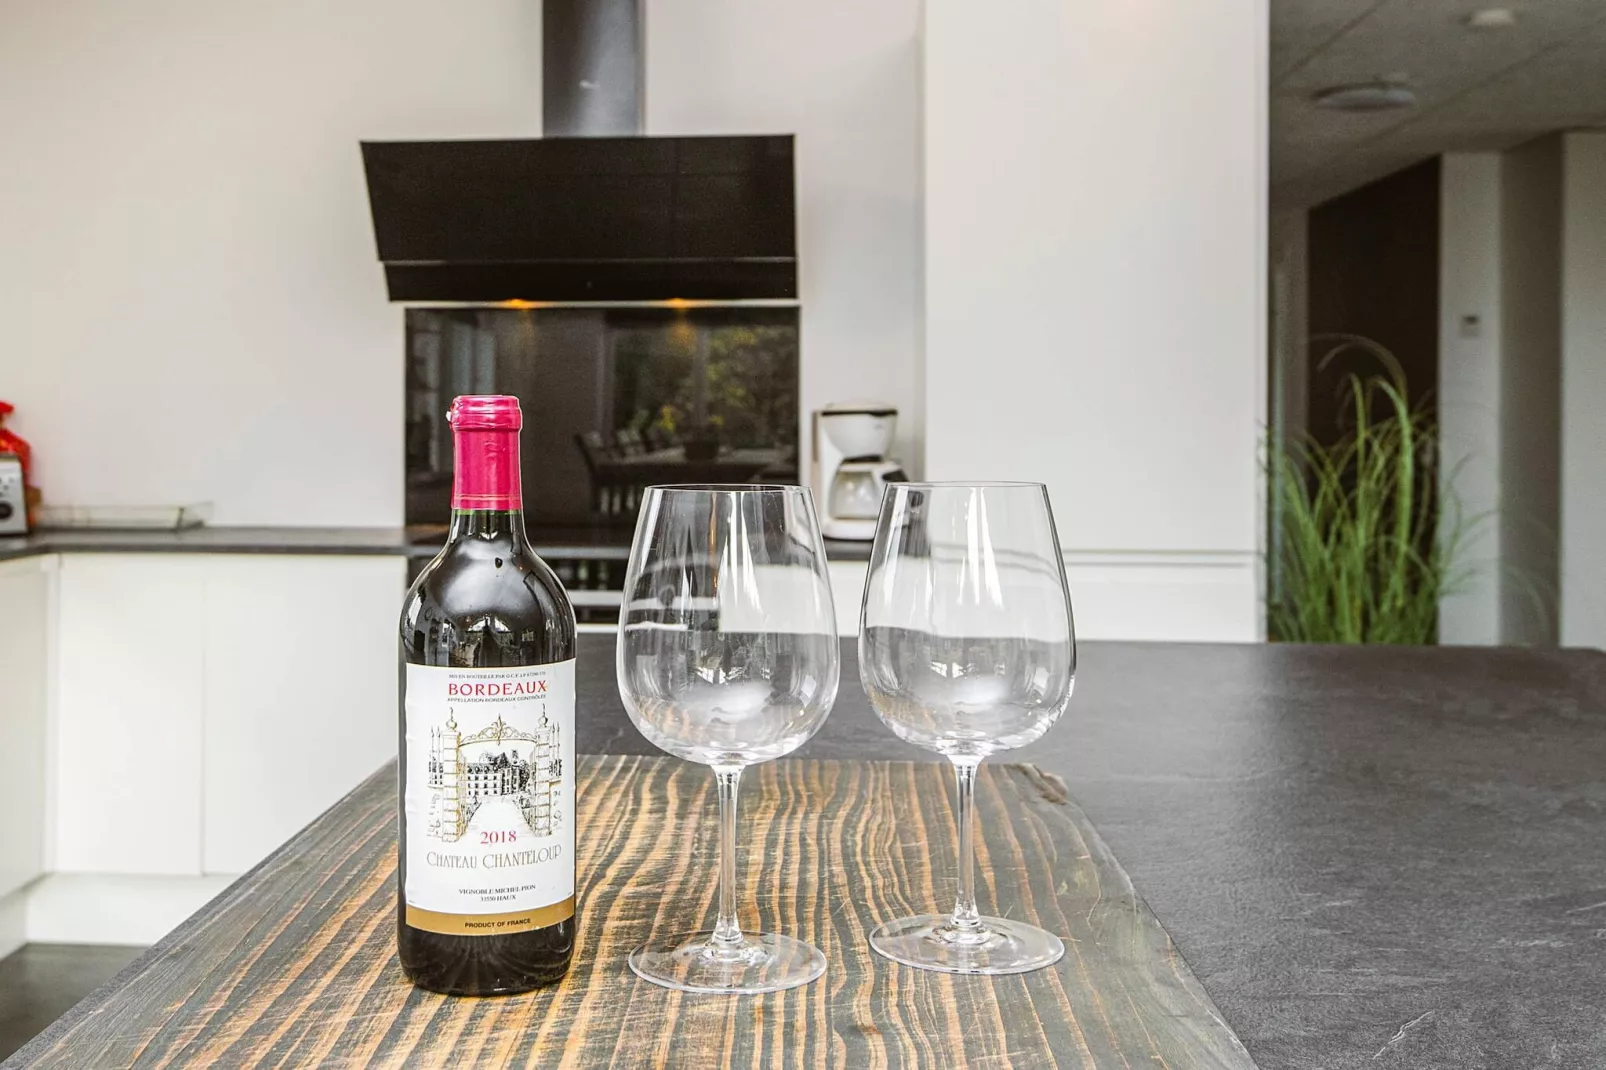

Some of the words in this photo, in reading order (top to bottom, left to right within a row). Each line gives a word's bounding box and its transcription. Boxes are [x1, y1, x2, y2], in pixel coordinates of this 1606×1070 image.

[448, 680, 547, 696] BORDEAUX
[480, 830, 517, 844] 2018
[426, 851, 477, 869] CHATEAU
[482, 844, 562, 869] CHANTELOUP
[494, 886, 519, 894] MICHEL
[507, 918, 531, 926] FRANCE
